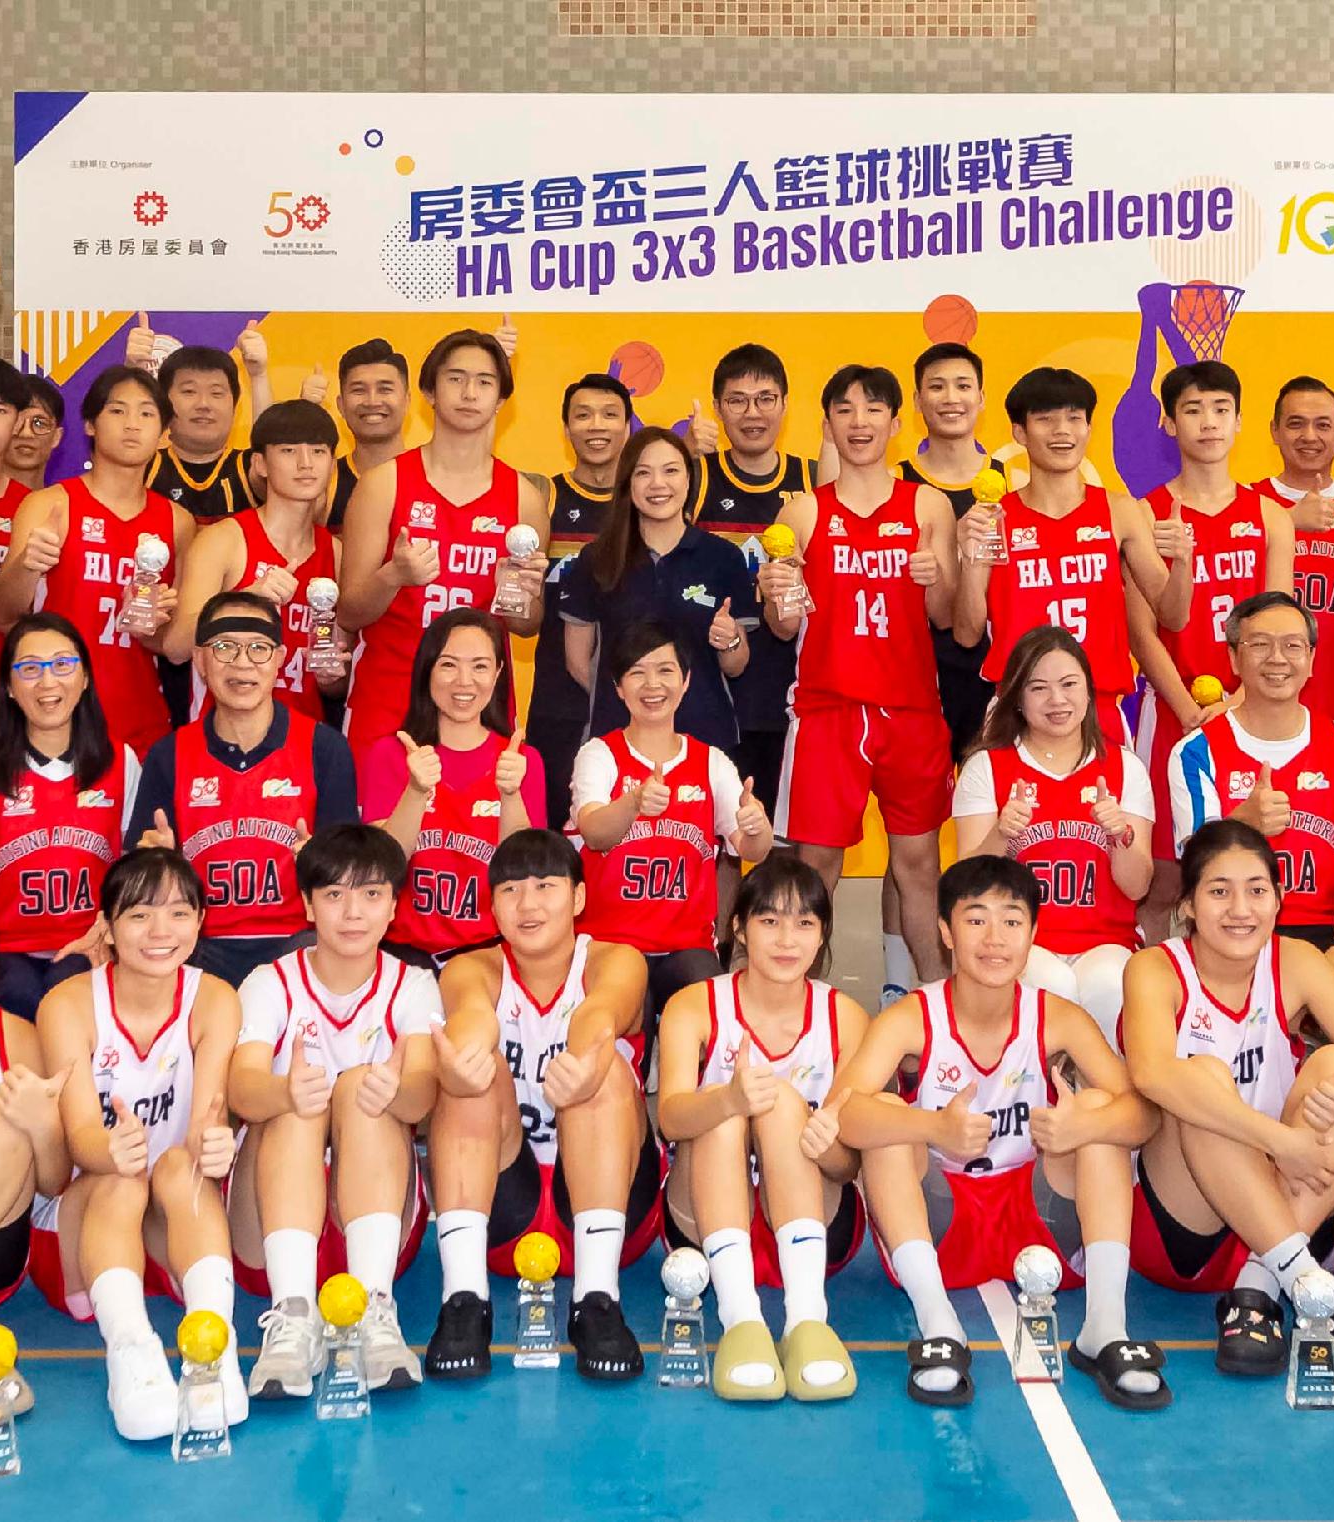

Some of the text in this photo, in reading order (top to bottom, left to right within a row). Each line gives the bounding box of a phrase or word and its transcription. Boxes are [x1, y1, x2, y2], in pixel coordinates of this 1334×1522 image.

[409, 133, 1073, 242] 房委會盃三人籃球挑戰賽
[72, 239, 228, 255] 香港房屋委員會
[456, 186, 1234, 299] HA Cup 3x3 Basketball Challenge
[84, 551, 111, 583] HA
[448, 543, 496, 576] CUP
[833, 545, 907, 578] HA CUP
[1017, 553, 1107, 588] HA CUP
[1213, 550, 1256, 580] CUP
[854, 589, 888, 637] 14
[1047, 597, 1086, 643] 15
[133, 1084, 174, 1127] CUP
